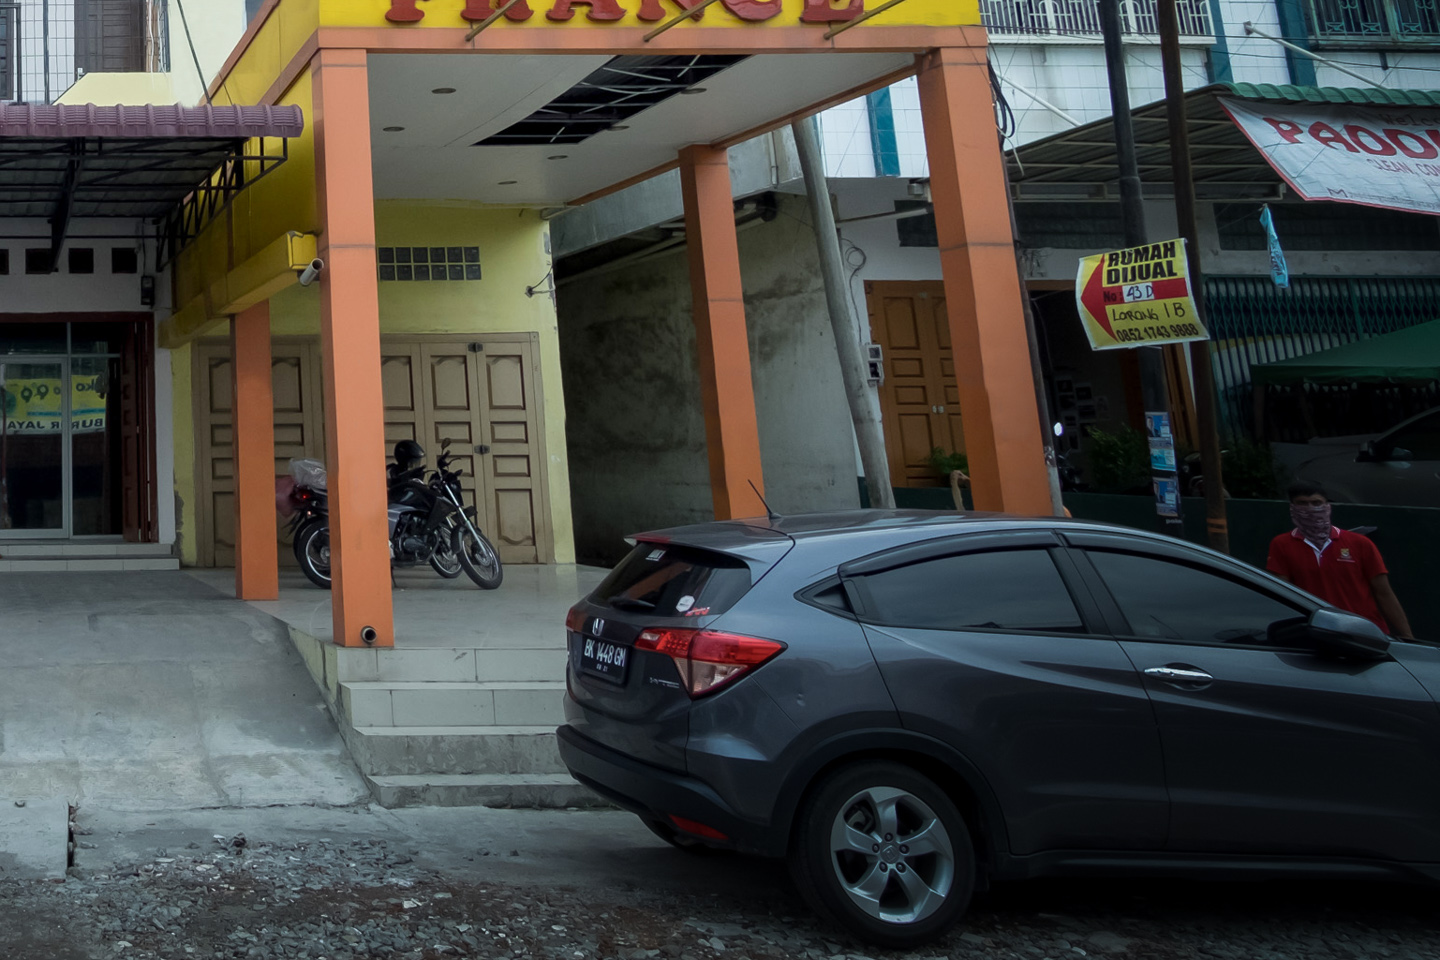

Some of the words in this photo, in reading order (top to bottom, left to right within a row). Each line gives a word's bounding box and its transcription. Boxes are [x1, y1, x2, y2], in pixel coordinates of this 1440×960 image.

[1107, 241, 1176, 268] RUMAH
[1106, 260, 1178, 285] DIJUAL
[1173, 302, 1186, 318] B
[1116, 327, 1144, 343] 0852
[1144, 325, 1171, 340] 1743
[1171, 323, 1199, 338] 9888
[584, 639, 595, 658] BK
[596, 642, 615, 664] 1448
